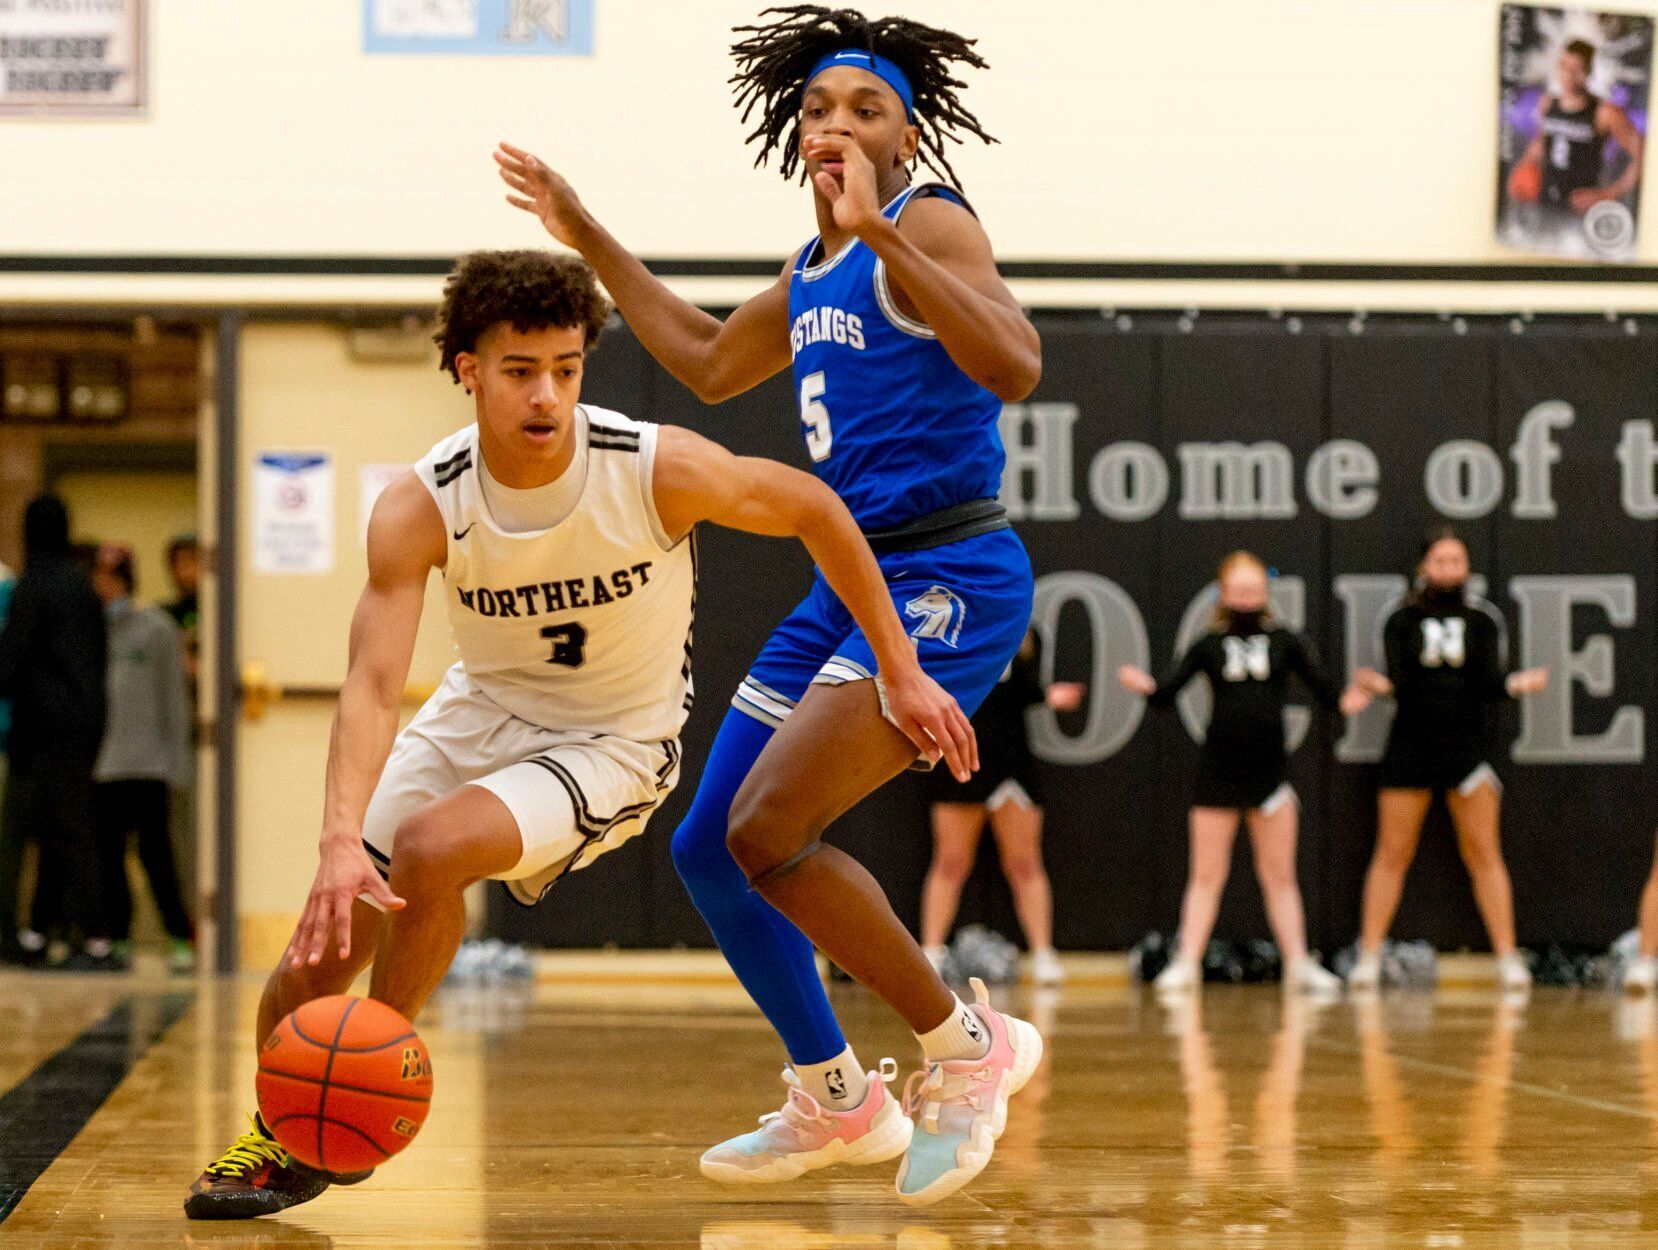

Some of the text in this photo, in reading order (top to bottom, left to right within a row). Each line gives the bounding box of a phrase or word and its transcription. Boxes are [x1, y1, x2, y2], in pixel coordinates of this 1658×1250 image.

[800, 370, 833, 463] 5
[1001, 402, 1380, 521] Home
[1423, 400, 1576, 521] of
[456, 560, 653, 618] NORTHEAST
[1221, 633, 1271, 683] N
[1421, 615, 1467, 669] N
